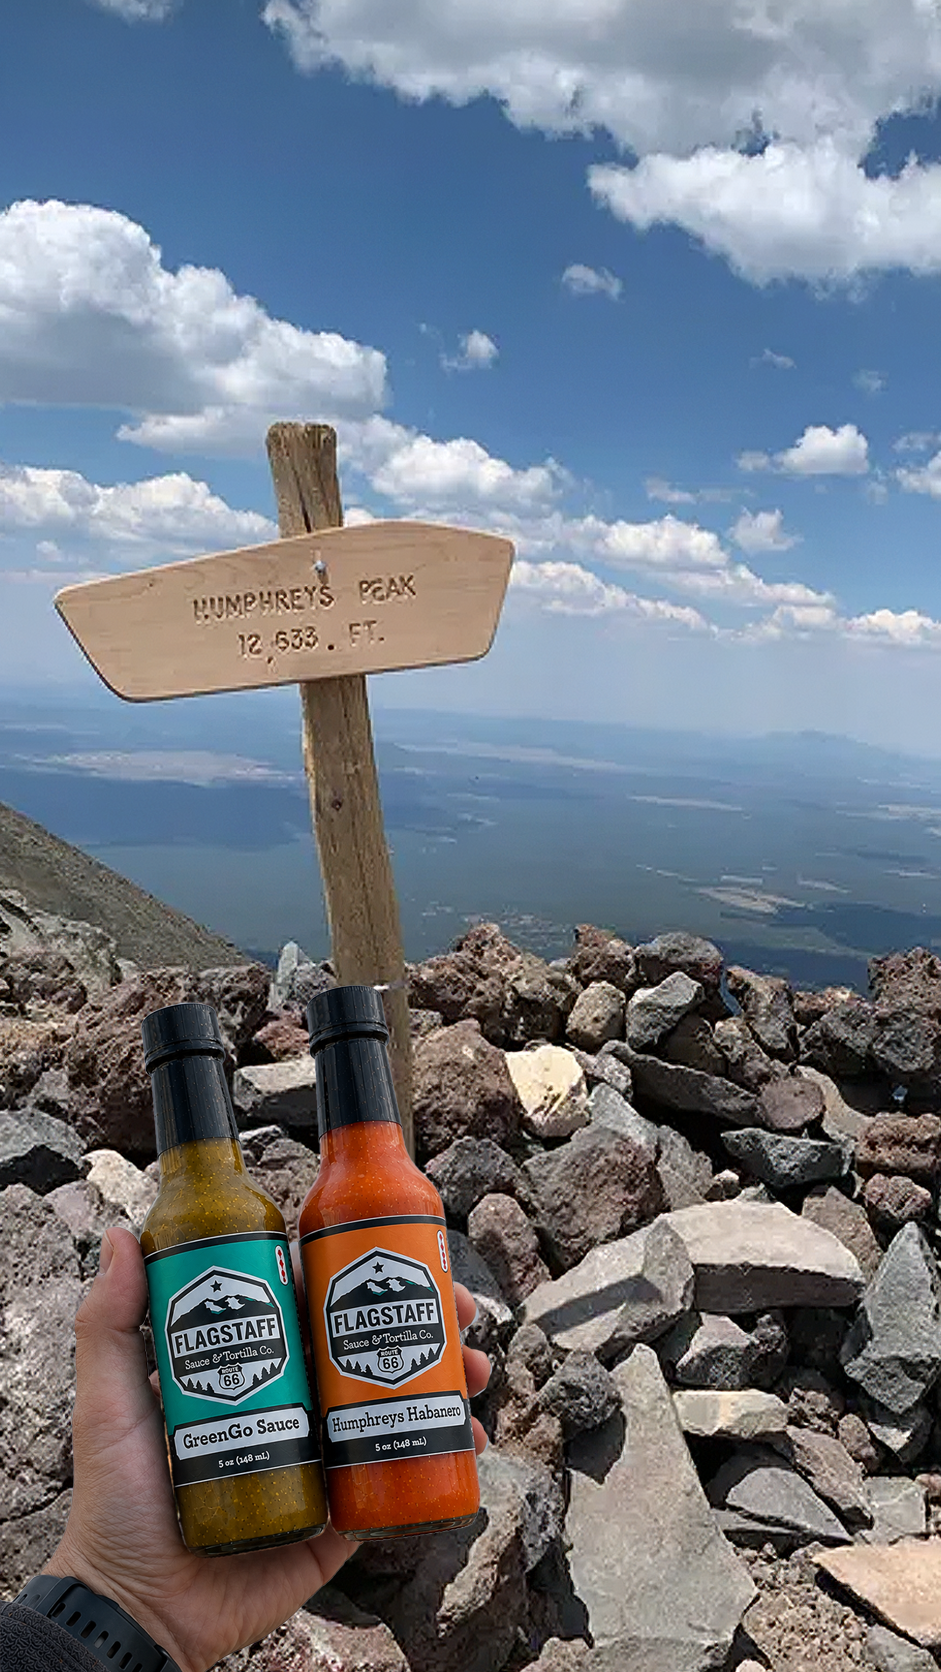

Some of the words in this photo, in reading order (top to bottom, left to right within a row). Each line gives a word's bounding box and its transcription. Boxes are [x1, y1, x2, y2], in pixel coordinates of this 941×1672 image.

[193, 585, 334, 620] HUMPHREYS
[359, 575, 416, 602] PEAK
[333, 1302, 435, 1334] FLAGSTAFF
[174, 1317, 276, 1354] FLAGSTAFF
[343, 1339, 370, 1350] Sauce
[371, 1334, 382, 1345] &
[382, 1330, 418, 1344] Tortilla
[419, 1329, 434, 1339] Co.
[185, 1359, 210, 1370] Sauce
[212, 1353, 222, 1364] &
[222, 1346, 259, 1361] Tortilla
[259, 1345, 274, 1355] Co.
[380, 1349, 399, 1357] ROUTE
[382, 1356, 399, 1369] 66
[221, 1366, 239, 1374] ROUTE
[223, 1373, 240, 1387] 66
[331, 1411, 405, 1433] Humphreys
[406, 1403, 461, 1422] Habanero
[183, 1423, 253, 1450] GreenGo
[256, 1416, 300, 1435] Sauce
[375, 1443, 381, 1452] 5
[393, 1438, 411, 1450] (148
[411, 1436, 427, 1446] mL)
[218, 1459, 224, 1468] 5
[224, 1458, 235, 1466] oz
[235, 1454, 254, 1466] (148
[254, 1450, 270, 1462] mL)
